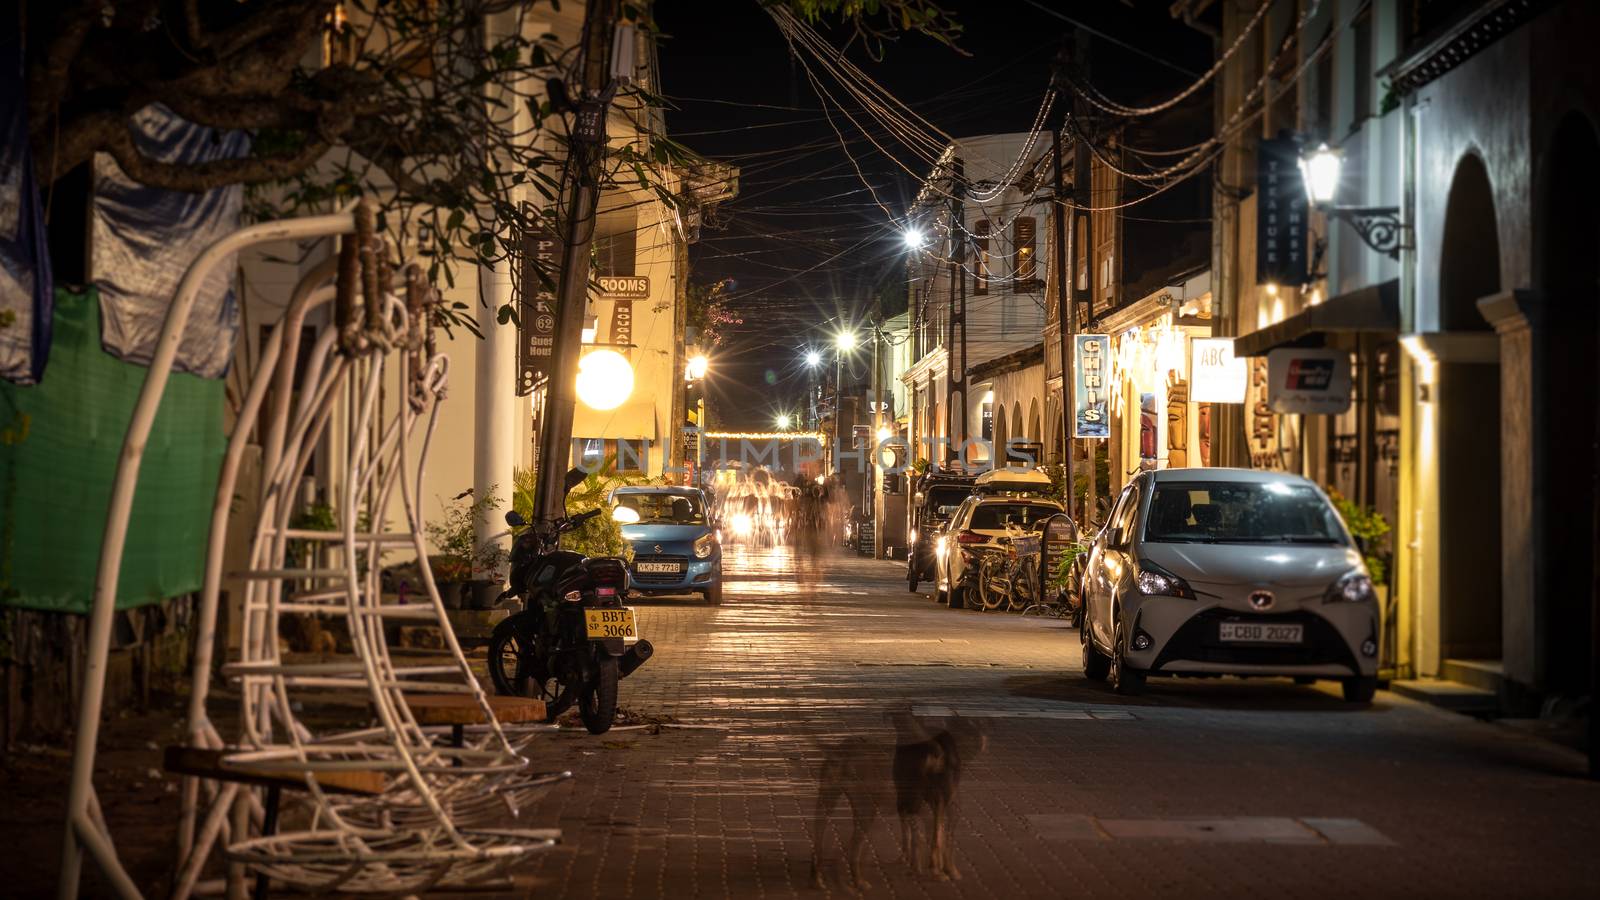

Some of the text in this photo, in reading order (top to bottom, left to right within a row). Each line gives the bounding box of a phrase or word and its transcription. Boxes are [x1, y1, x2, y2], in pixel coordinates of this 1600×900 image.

[1267, 161, 1277, 263] TREASURE
[1289, 201, 1300, 262] CHEST
[600, 279, 647, 292] ROOMS
[537, 318, 552, 330] 62
[530, 335, 553, 346] Gues
[529, 346, 552, 356] Hous
[1200, 347, 1225, 367] ABC
[1083, 339, 1101, 422] CHRIS
[589, 623, 600, 631] SP
[603, 624, 633, 638] 3066
[1266, 626, 1300, 641] 2027
